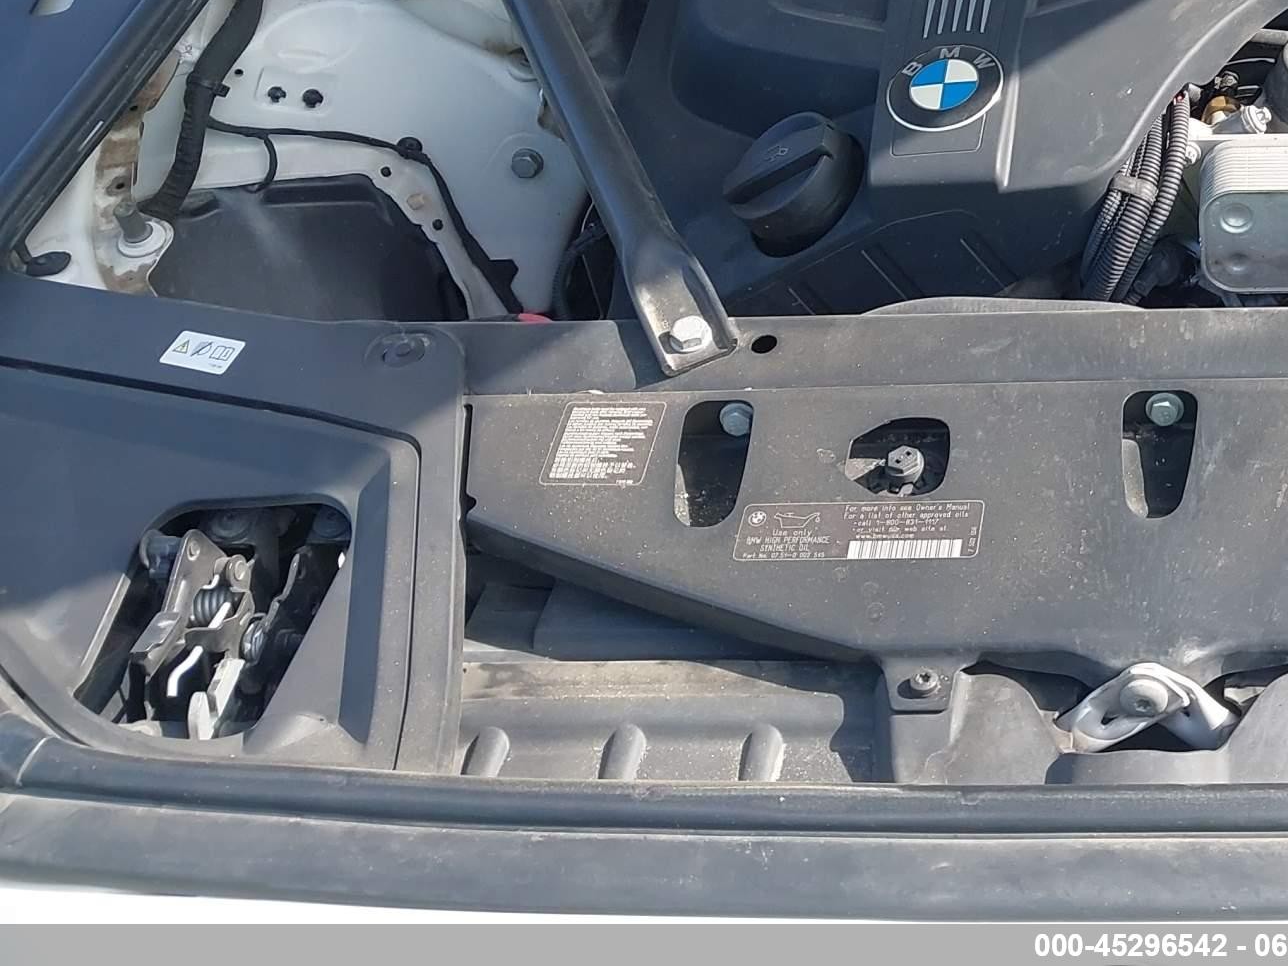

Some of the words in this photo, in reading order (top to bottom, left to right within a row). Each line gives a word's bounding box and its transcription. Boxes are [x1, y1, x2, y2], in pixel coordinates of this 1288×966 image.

[902, 47, 996, 76] BMW
[919, 512, 952, 520] approved
[793, 528, 813, 538] only
